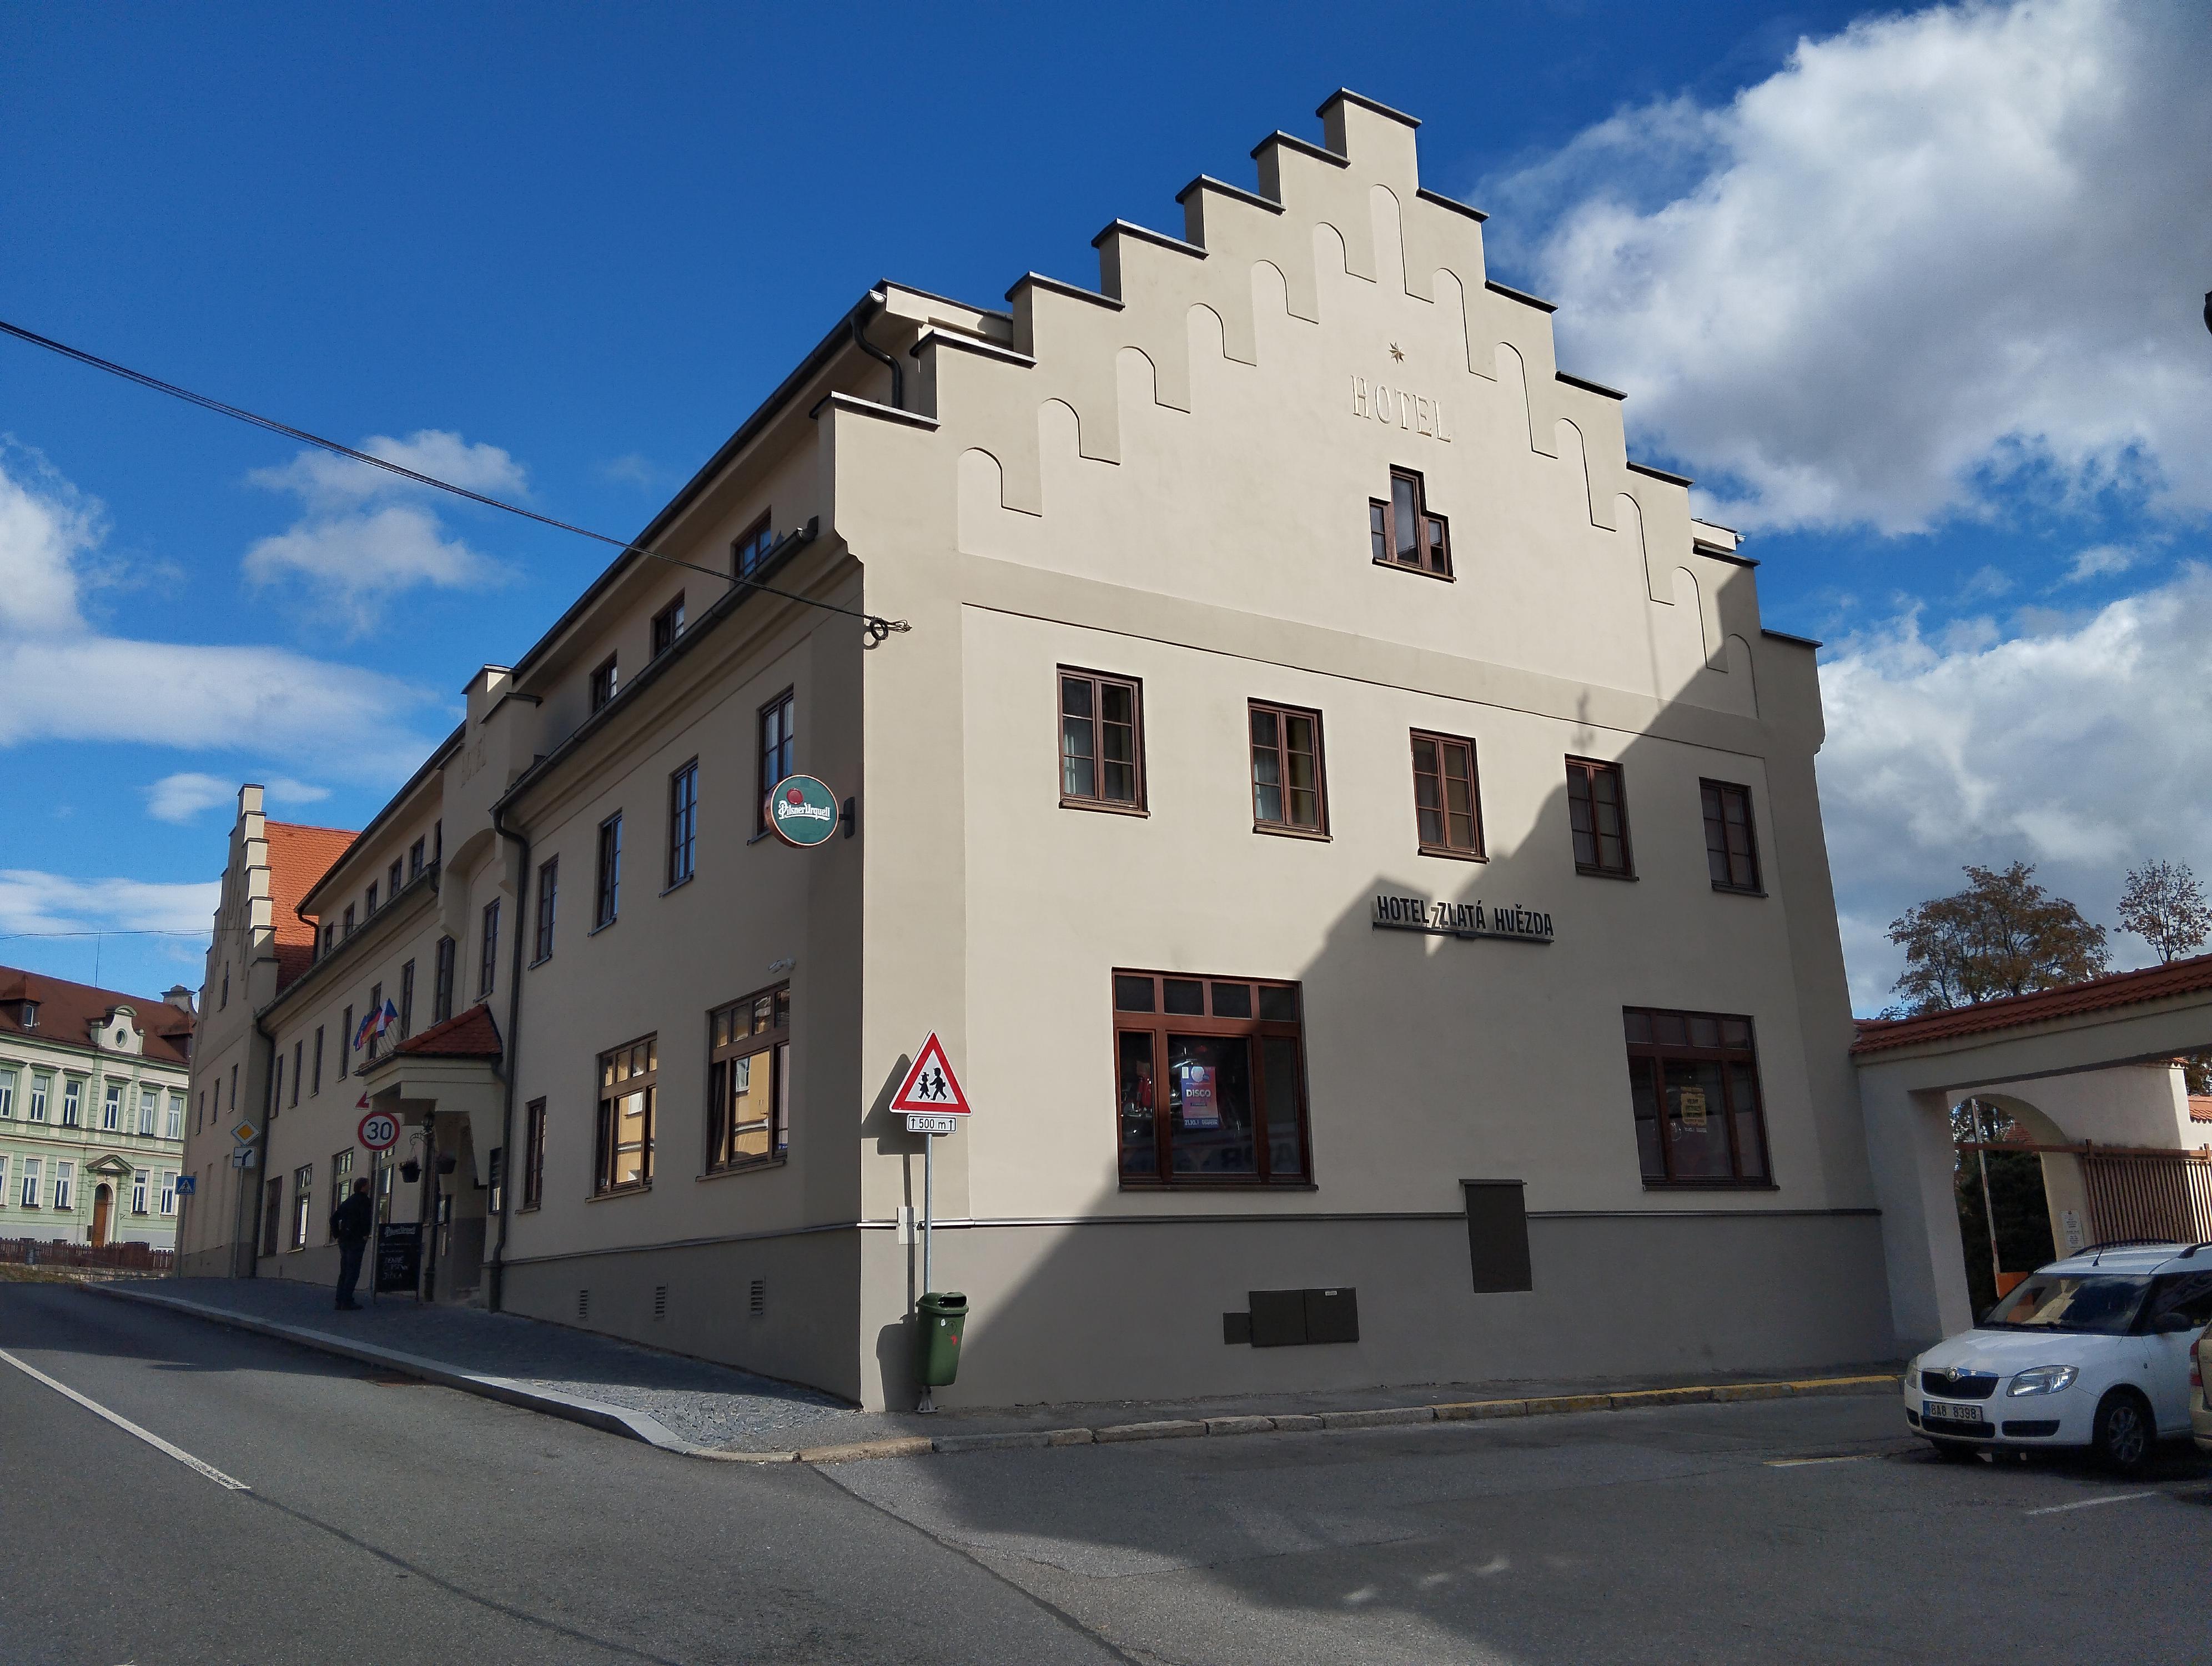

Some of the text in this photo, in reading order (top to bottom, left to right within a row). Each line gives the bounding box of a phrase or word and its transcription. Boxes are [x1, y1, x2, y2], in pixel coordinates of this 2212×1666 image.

[1350, 374, 1451, 443] HOTEL
[778, 800, 831, 820] Pilsner Urquell
[1377, 895, 1555, 936] HOTEL ZLATÁ HVĚZDA
[366, 1122, 393, 1140] 30
[919, 1118, 934, 1128] 500
[1952, 1406, 1976, 1419] 8398
